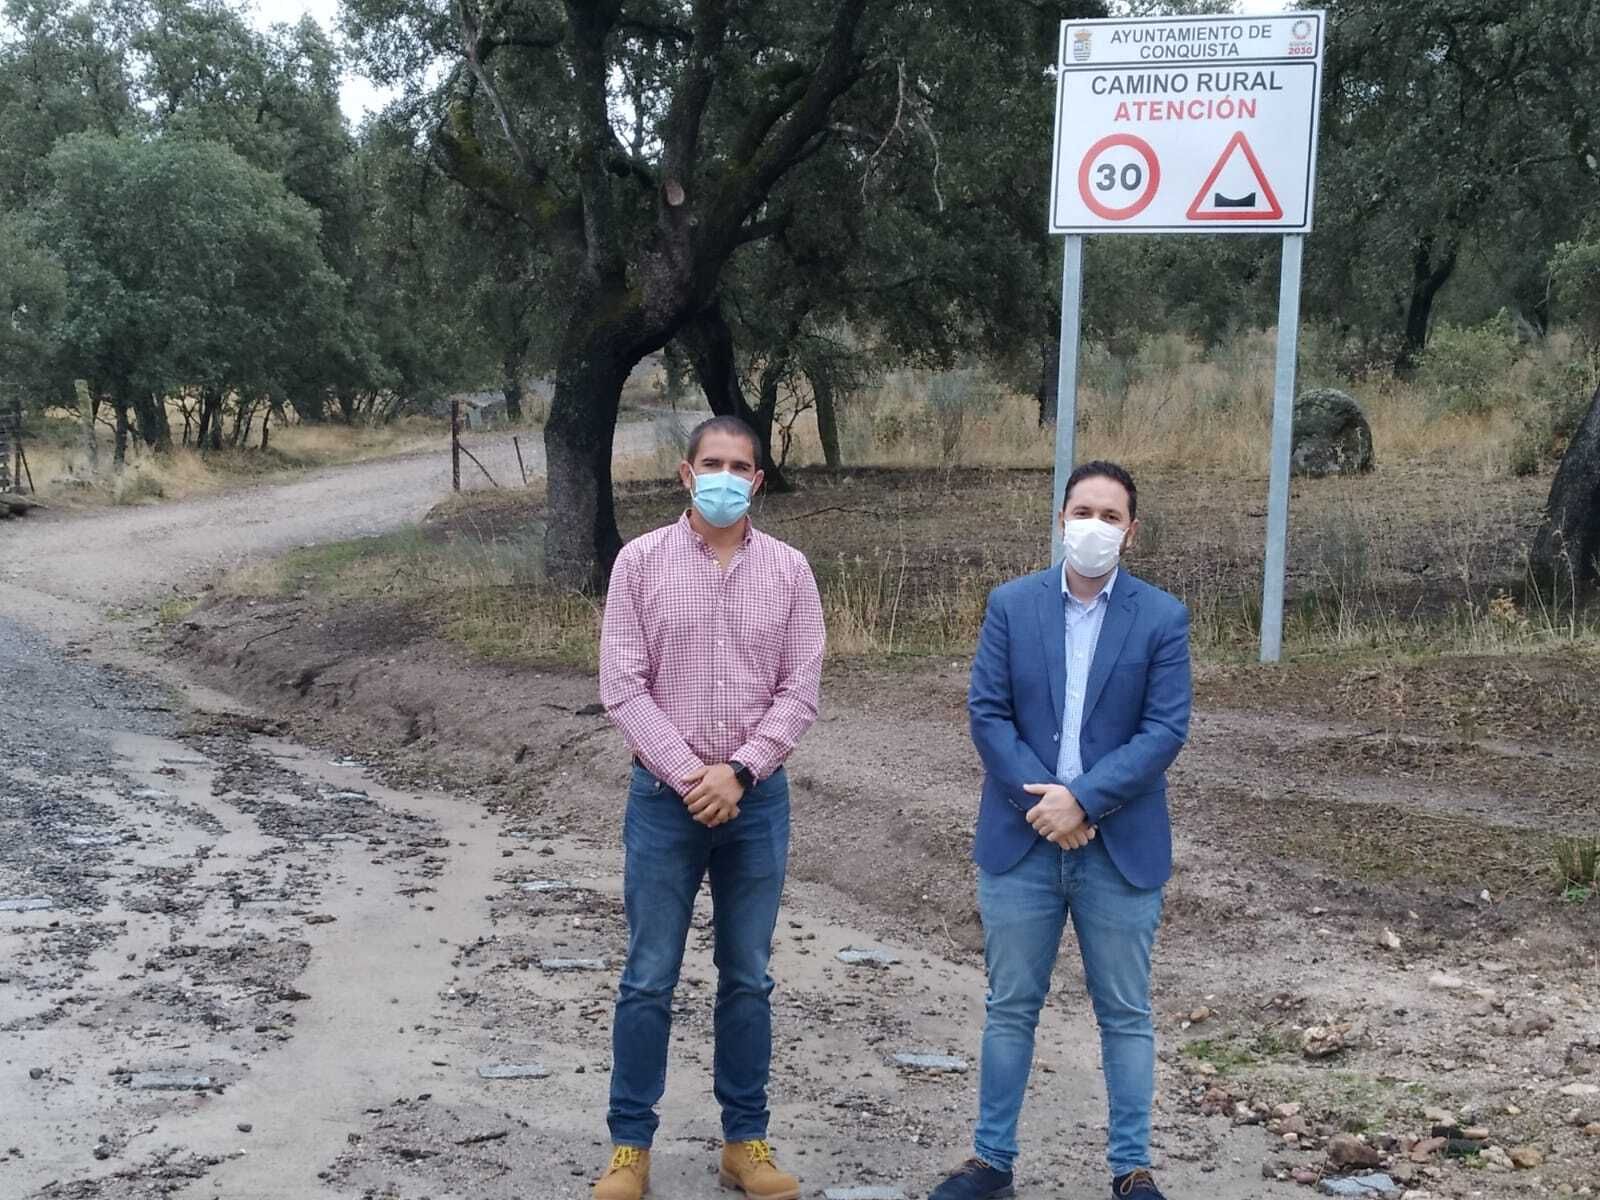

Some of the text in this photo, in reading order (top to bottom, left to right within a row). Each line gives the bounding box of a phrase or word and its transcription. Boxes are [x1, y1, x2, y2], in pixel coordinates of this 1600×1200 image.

[1111, 25, 1272, 44] AYUNTAMIENTO DE
[1140, 43, 1239, 60] CONQUISTA
[1288, 46, 1313, 55] 2030
[1091, 71, 1283, 95] CAMINO RURAL
[1114, 95, 1257, 121] ATENCIÓN
[1095, 163, 1142, 191] 30
